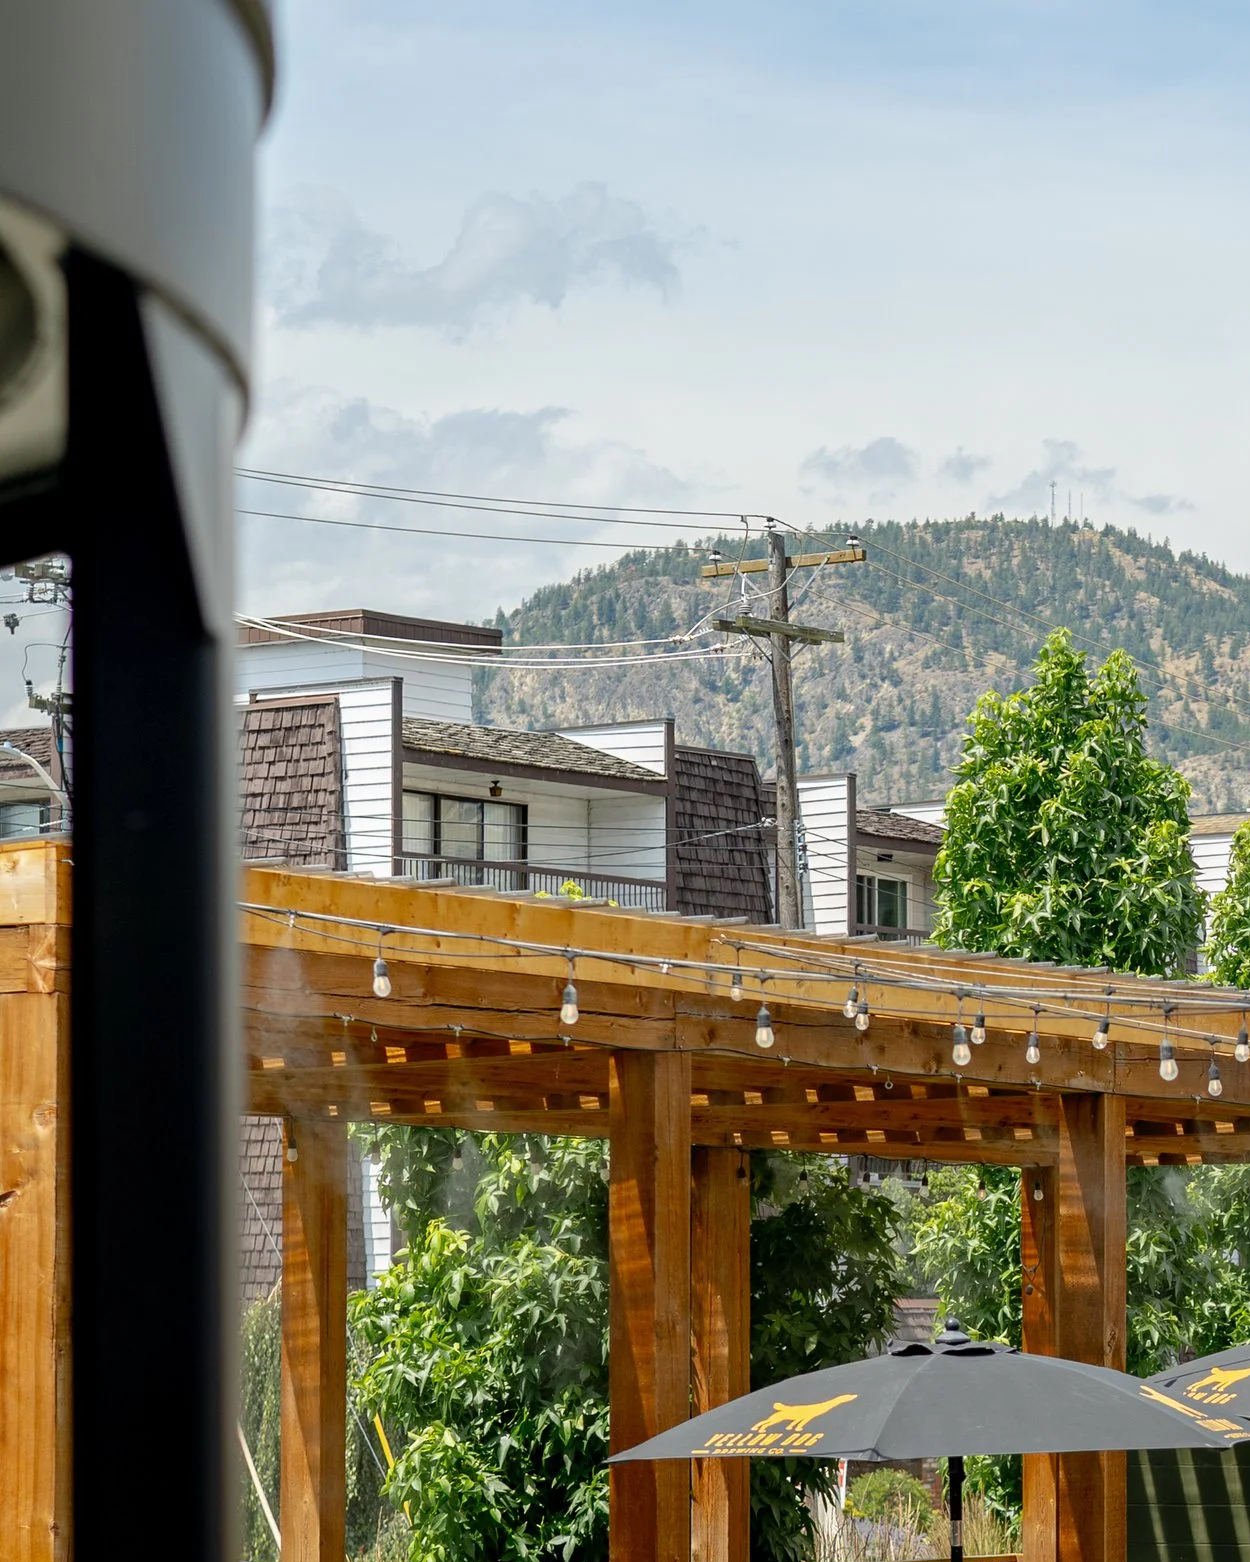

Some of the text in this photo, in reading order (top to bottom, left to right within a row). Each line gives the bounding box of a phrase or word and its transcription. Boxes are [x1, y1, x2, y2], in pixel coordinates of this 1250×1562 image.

[704, 1433, 825, 1447] YELLOW DOG
[711, 1447, 767, 1455] BREWING
